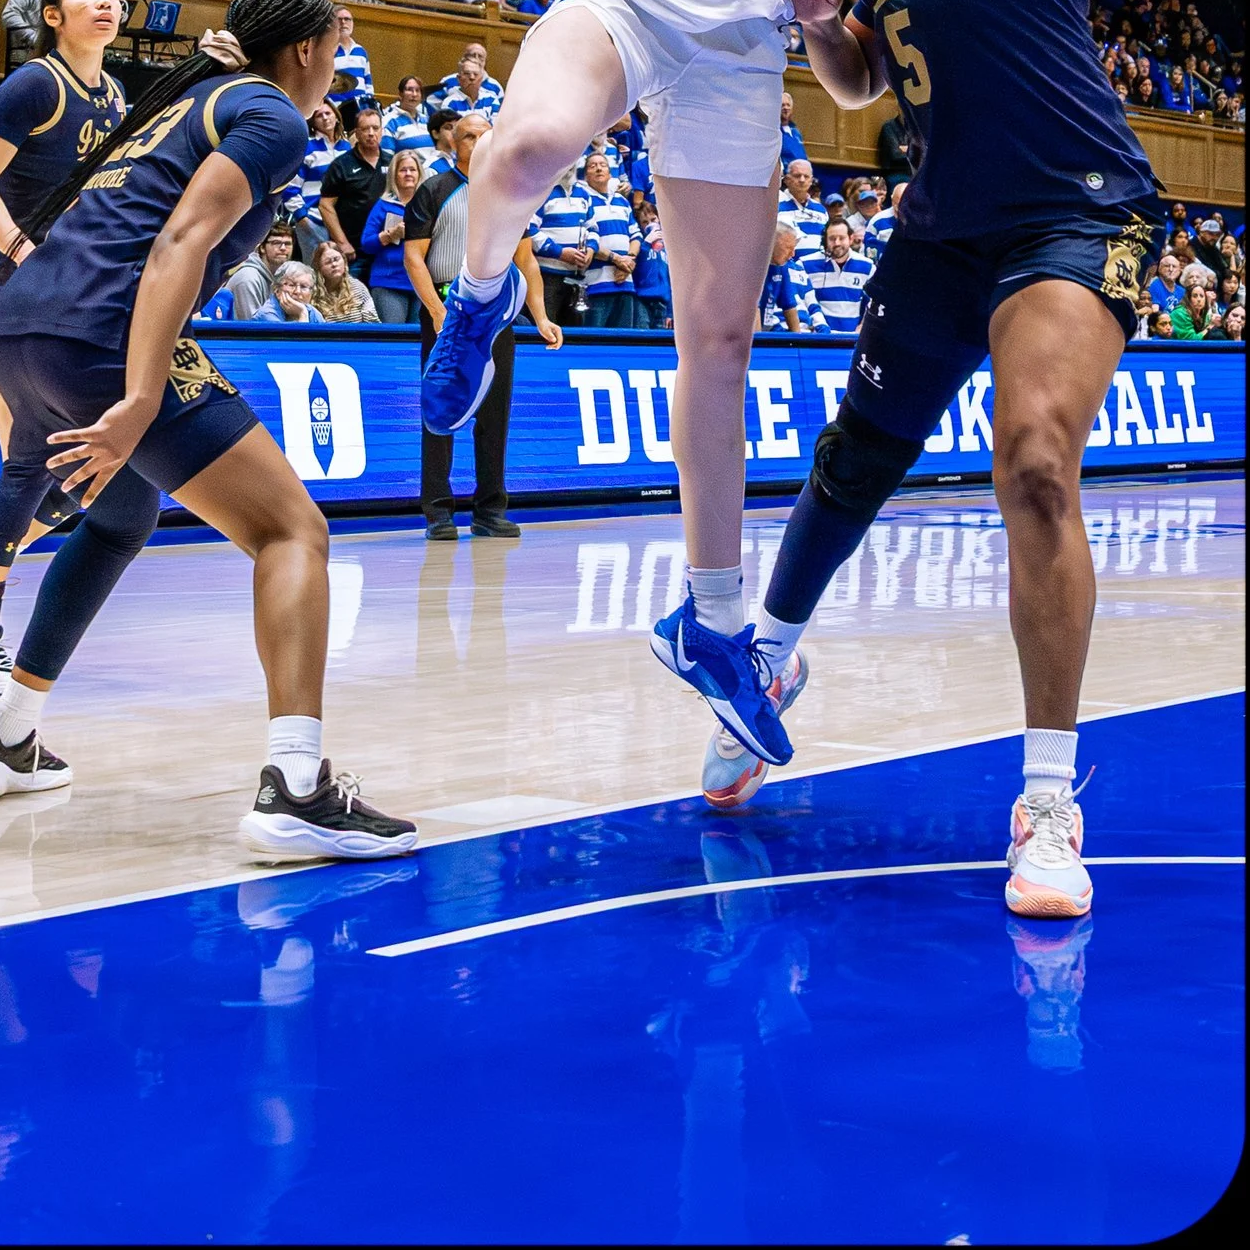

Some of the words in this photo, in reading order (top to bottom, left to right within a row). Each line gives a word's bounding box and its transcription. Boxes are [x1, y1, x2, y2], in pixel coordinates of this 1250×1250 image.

[884, 8, 931, 106] 5
[81, 166, 133, 190] MOORE
[568, 368, 801, 465] DUE
